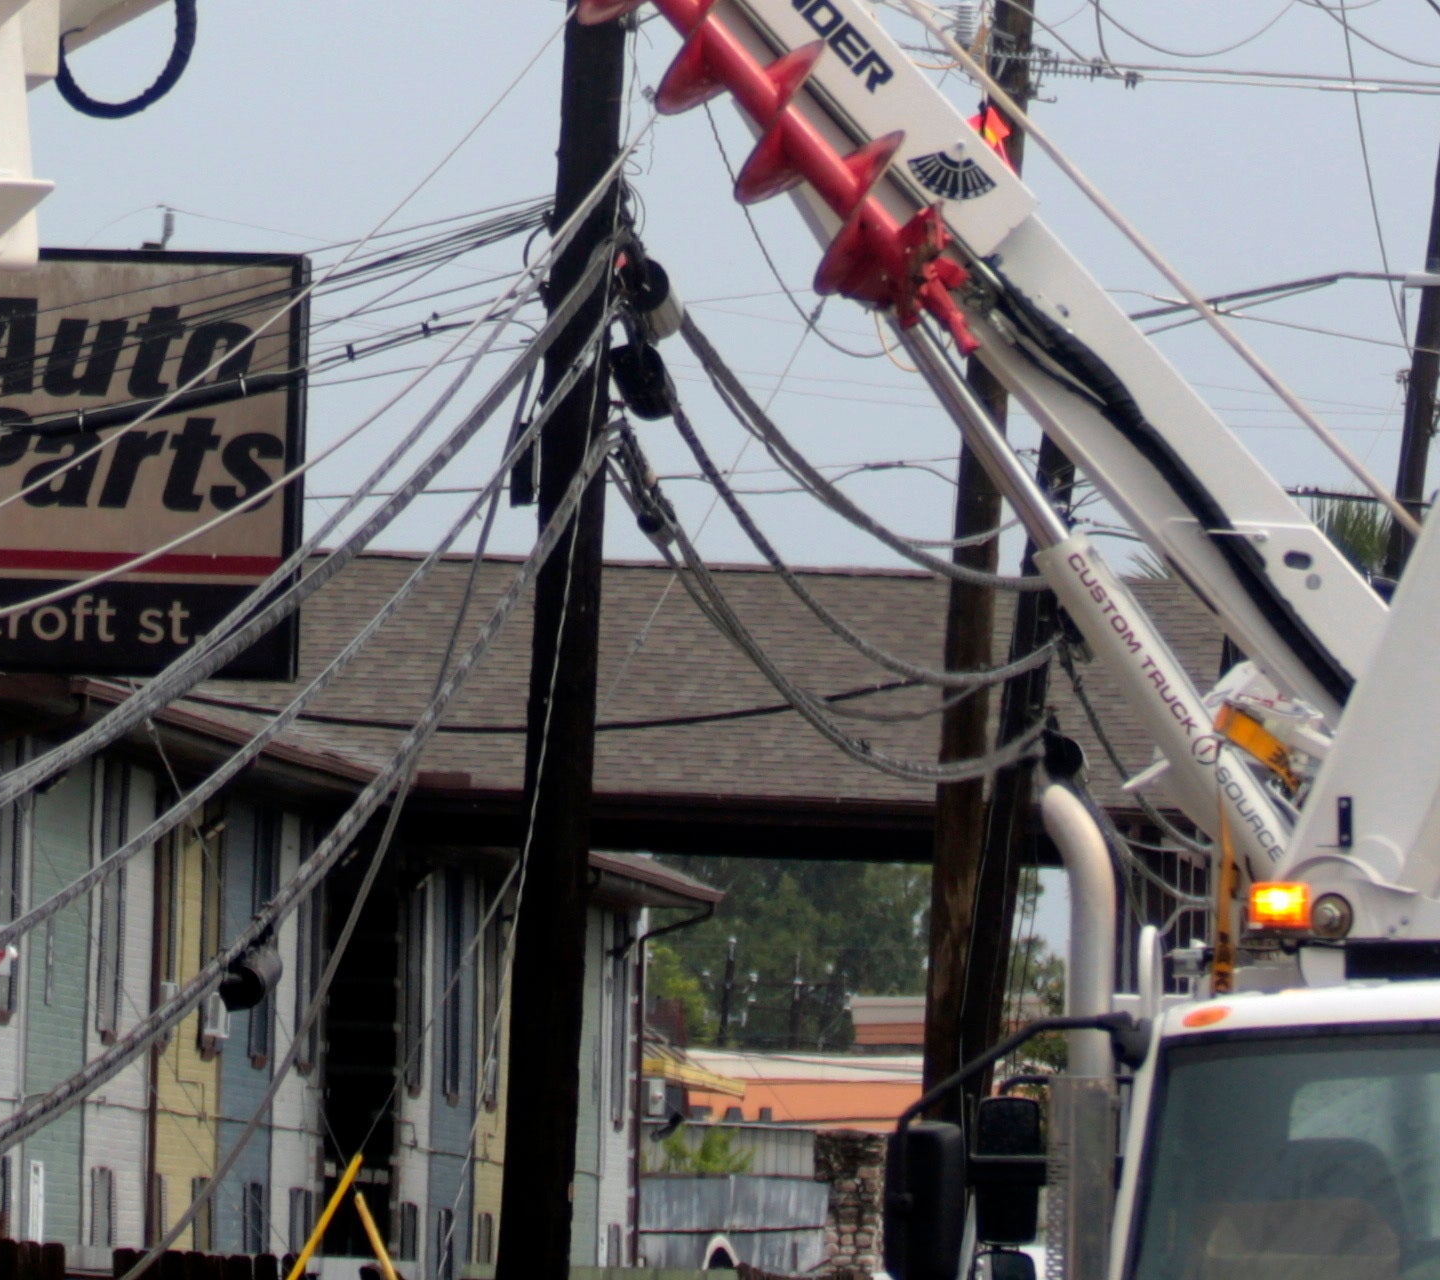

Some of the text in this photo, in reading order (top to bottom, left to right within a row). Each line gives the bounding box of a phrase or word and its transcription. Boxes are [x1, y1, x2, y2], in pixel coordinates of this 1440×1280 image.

[1067, 552, 1143, 654] CUSTOM
[1140, 655, 1199, 736] TRUCK
[1215, 766, 1286, 863] SOURCE
